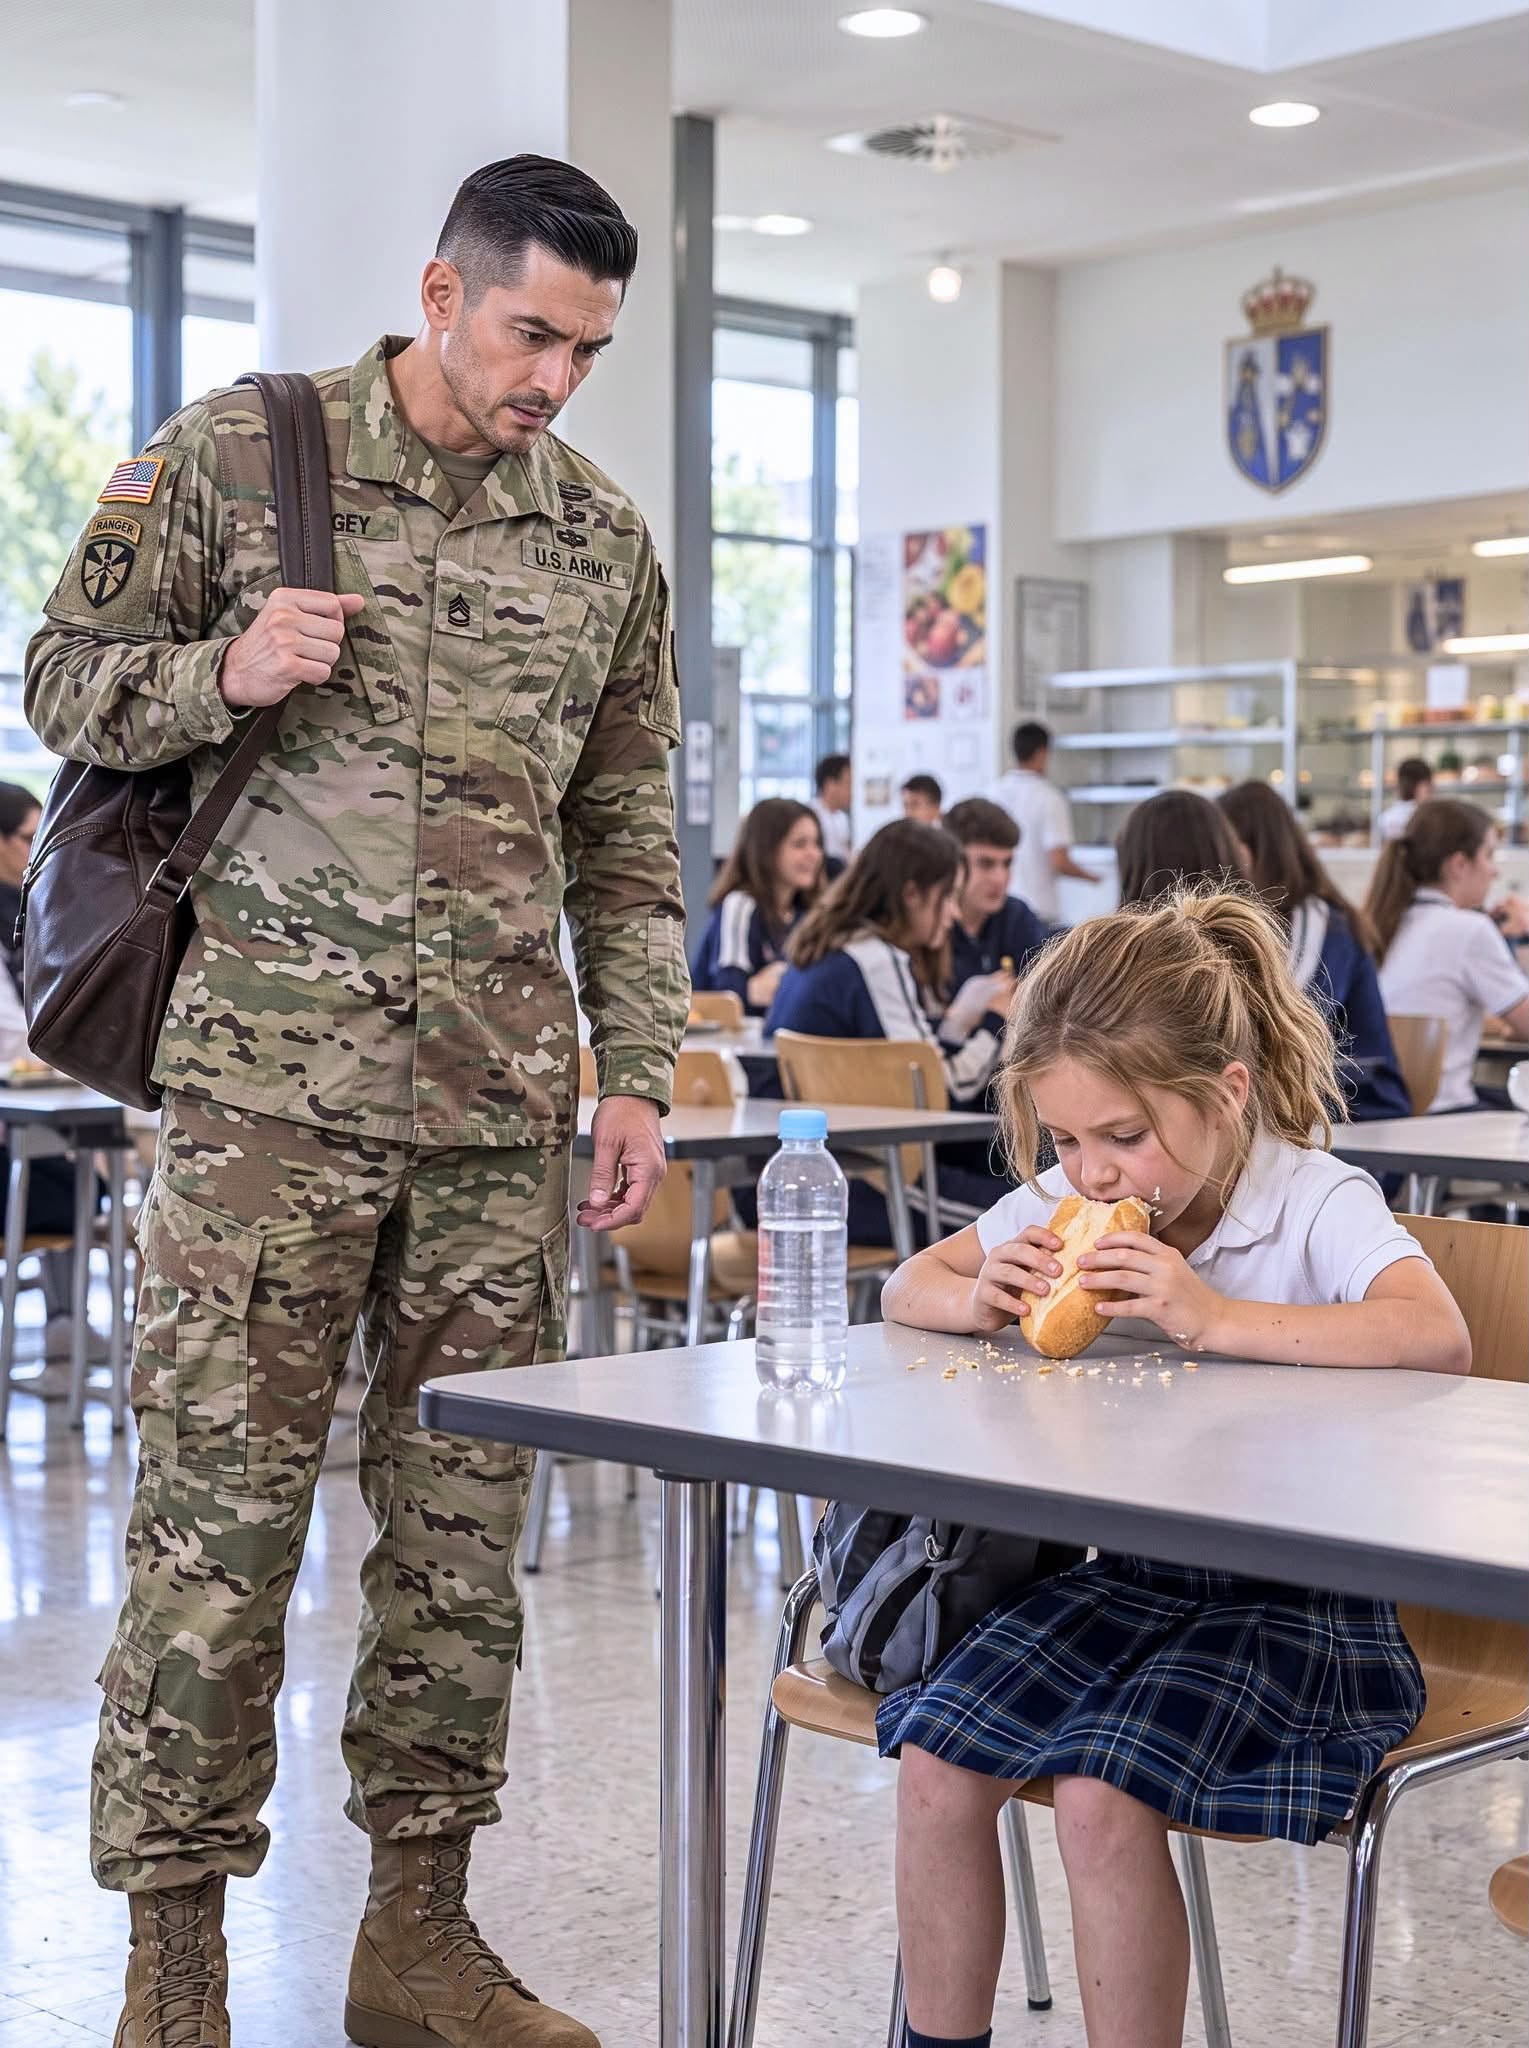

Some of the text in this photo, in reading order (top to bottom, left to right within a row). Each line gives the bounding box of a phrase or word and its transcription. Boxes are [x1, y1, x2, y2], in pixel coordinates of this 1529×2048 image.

[95, 520, 134, 536] RANGER
[331, 513, 371, 535] GEY
[535, 547, 614, 582] U.S. ARMY
